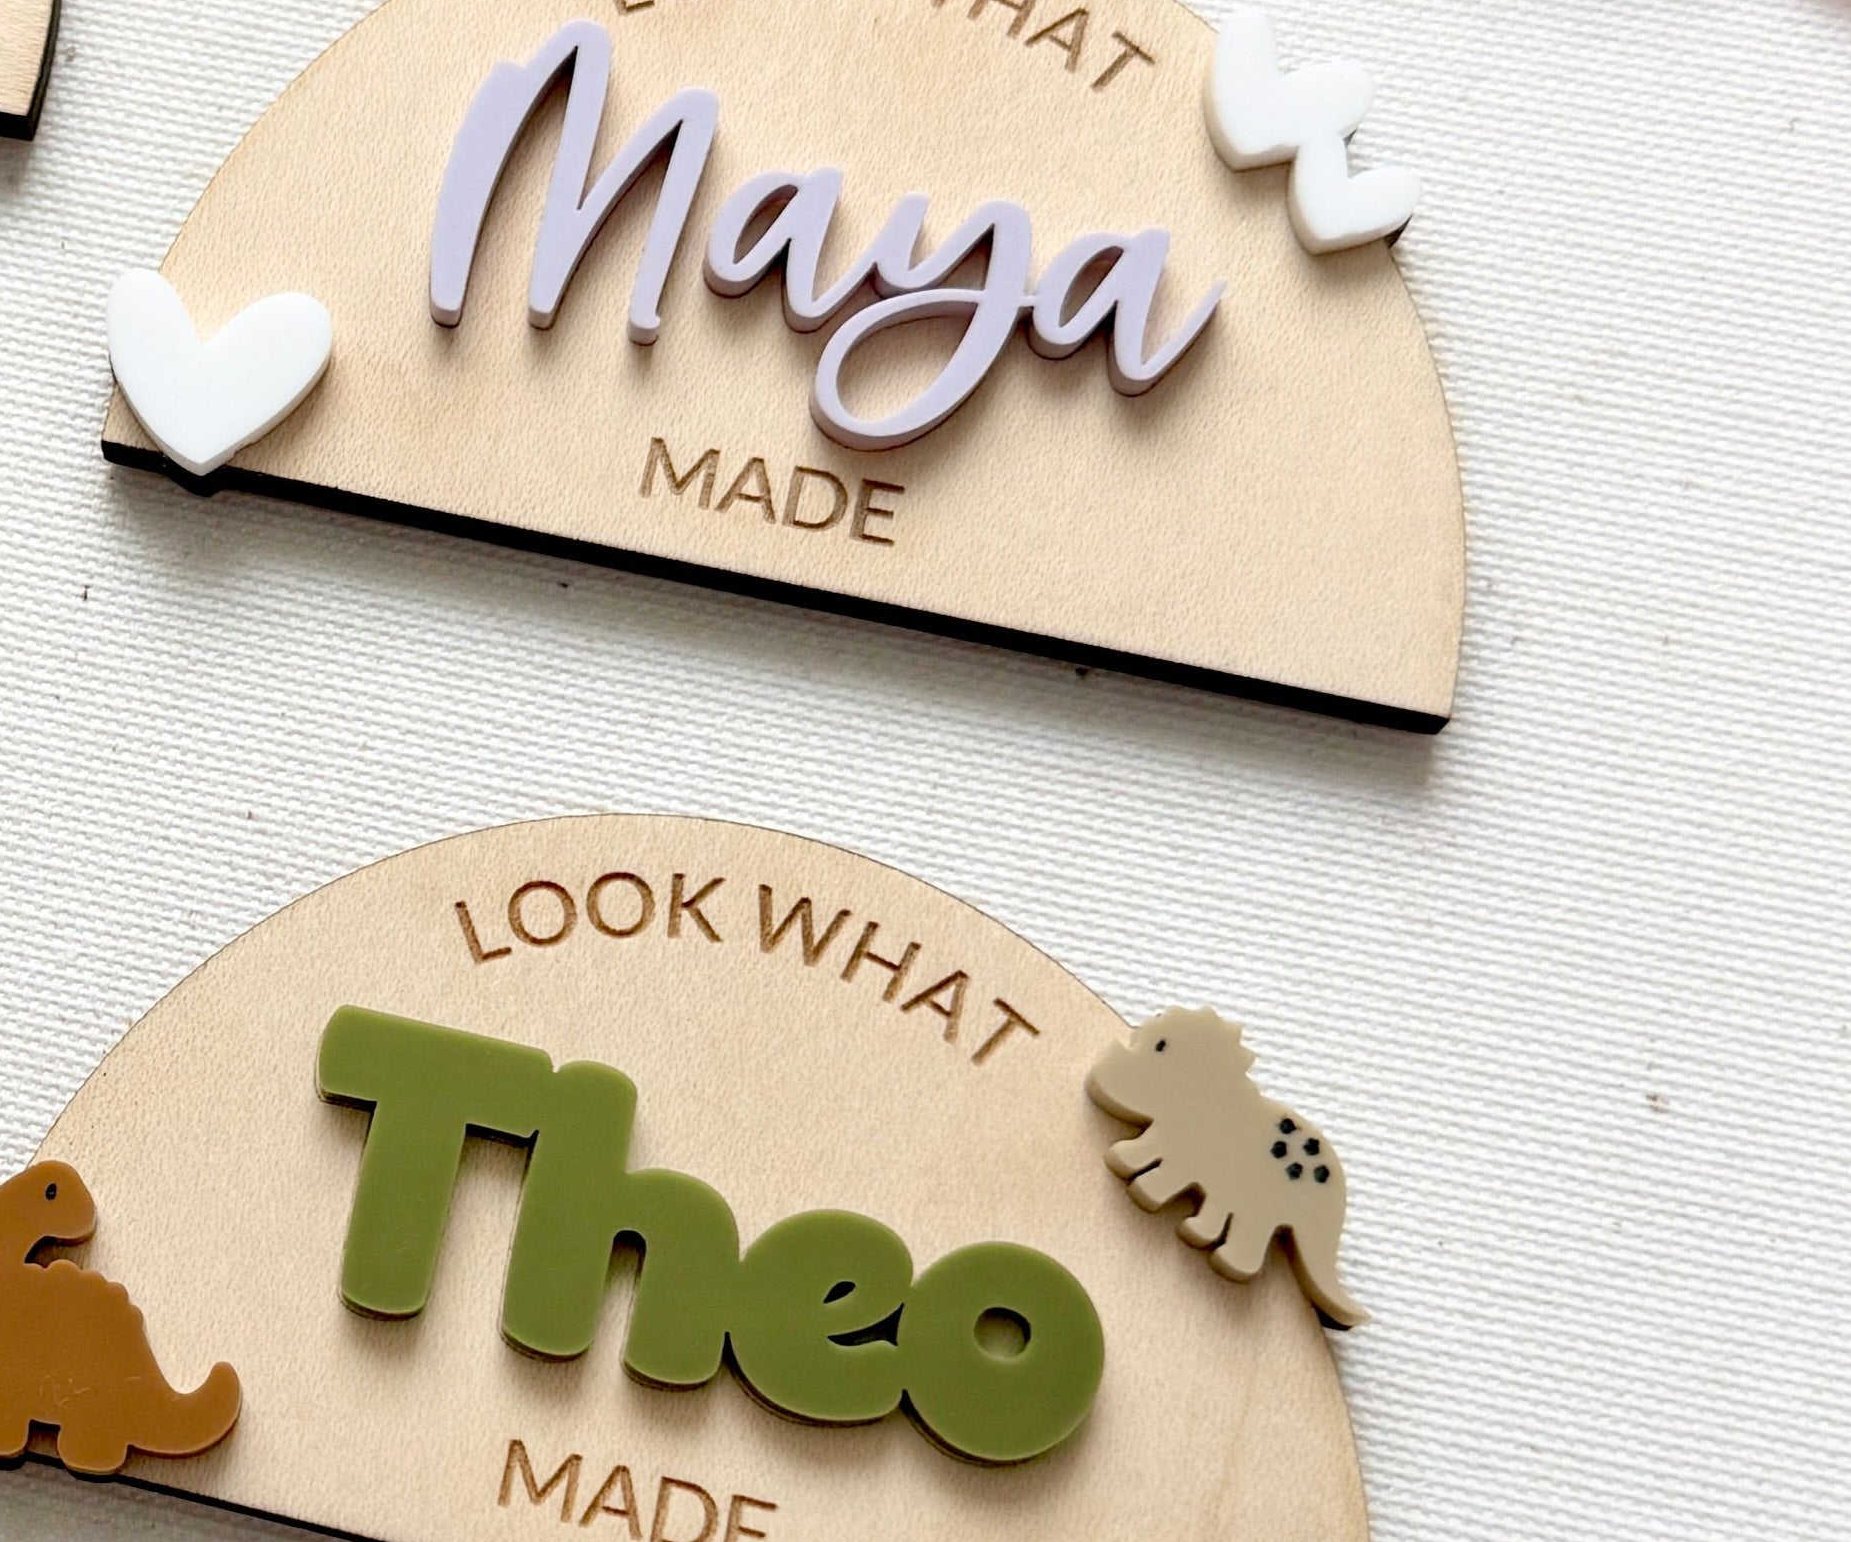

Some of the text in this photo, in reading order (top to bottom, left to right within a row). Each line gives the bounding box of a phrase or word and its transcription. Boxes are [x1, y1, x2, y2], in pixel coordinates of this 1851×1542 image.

[429, 20, 1225, 452] Maya
[639, 436, 906, 547] MADE
[454, 870, 1041, 1065] LOOK WHAT
[315, 1004, 1105, 1467] Theo
